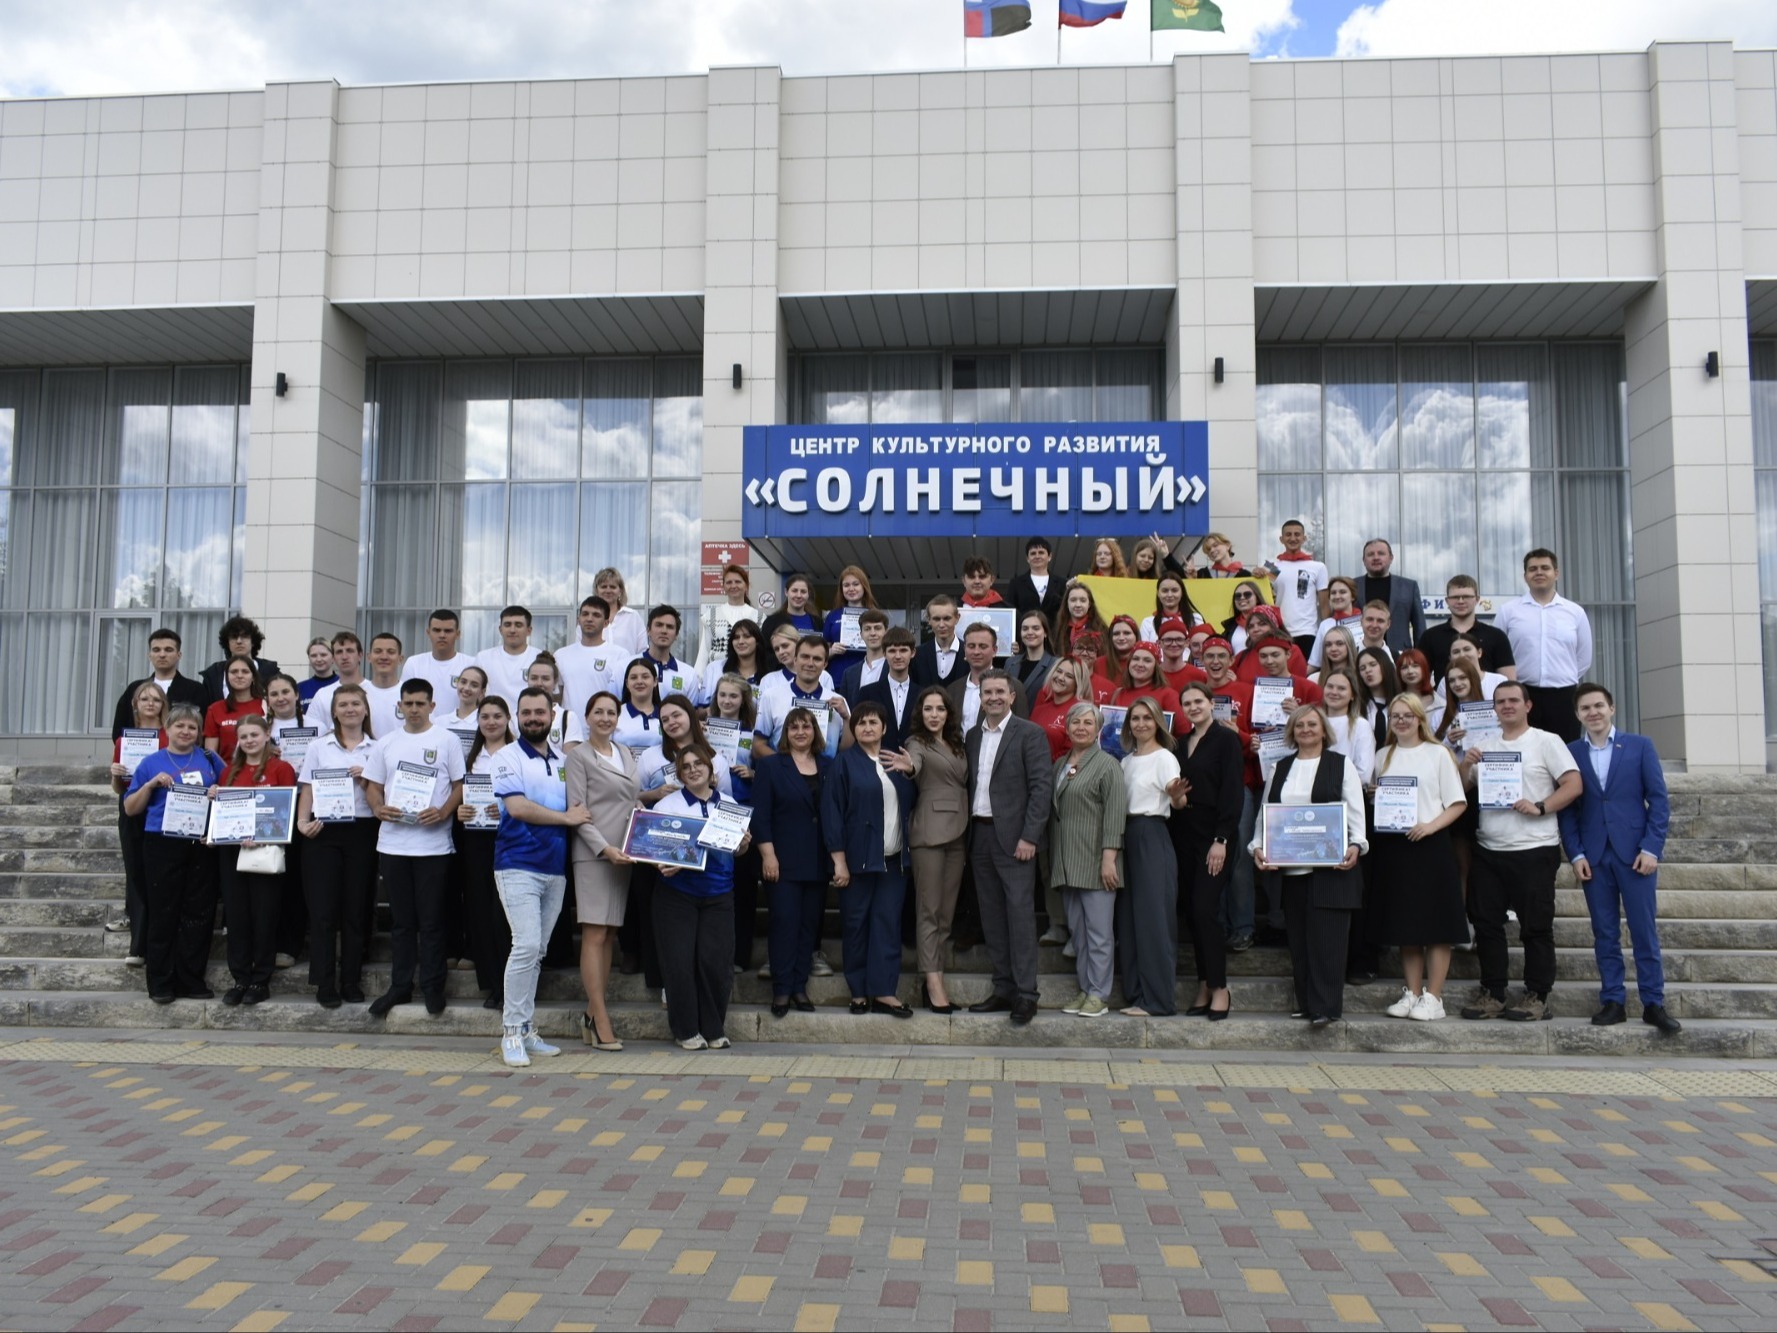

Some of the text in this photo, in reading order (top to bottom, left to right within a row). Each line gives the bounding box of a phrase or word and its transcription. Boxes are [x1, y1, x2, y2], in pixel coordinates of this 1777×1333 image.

[790, 435, 1160, 457] ЦЕНТР КУЛЬТУРНОГО РАЗВИТИЯ
[745, 453, 1207, 513] «СОЛНЕЧНЫЙ»
